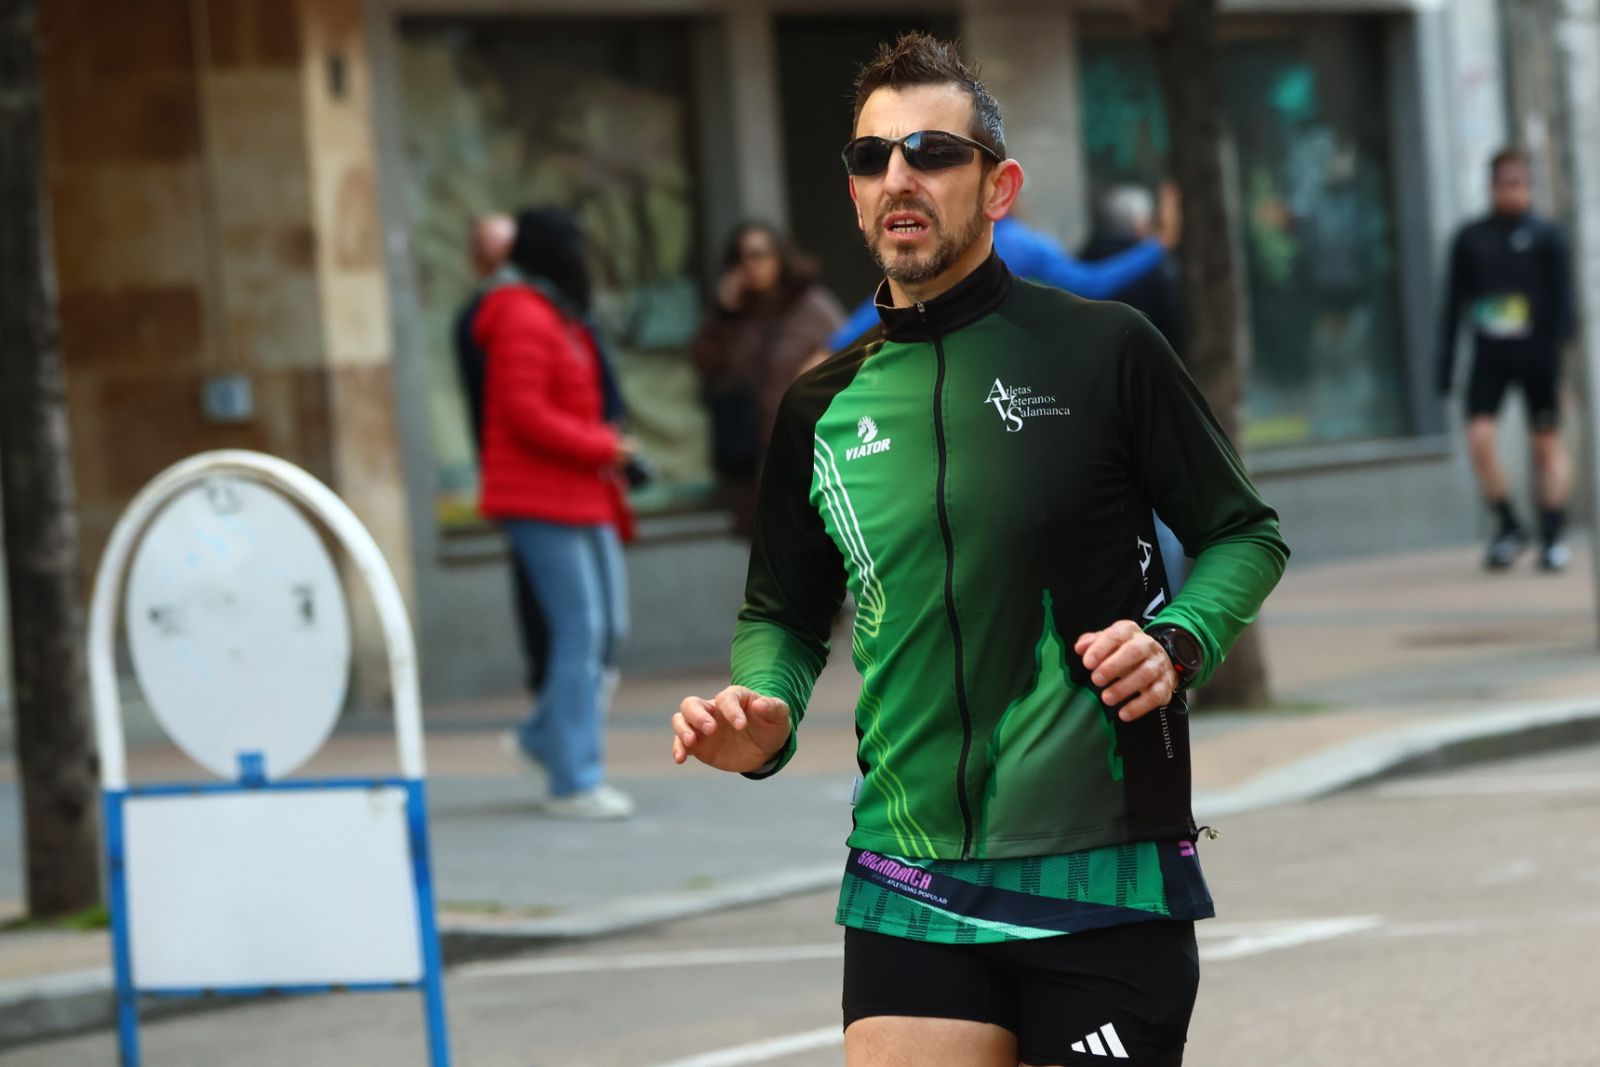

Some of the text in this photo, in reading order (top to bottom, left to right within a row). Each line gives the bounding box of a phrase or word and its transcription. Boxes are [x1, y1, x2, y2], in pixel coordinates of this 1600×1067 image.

[984, 377, 1032, 404] Atletas
[990, 395, 1056, 421] Veteranos
[1006, 406, 1071, 432] Salamanca
[845, 438, 891, 462] VIATOR
[1160, 705, 1174, 759] lamanca
[857, 850, 932, 890] SALAMANCA
[886, 879, 948, 905] ATLETISMO POPULAR
